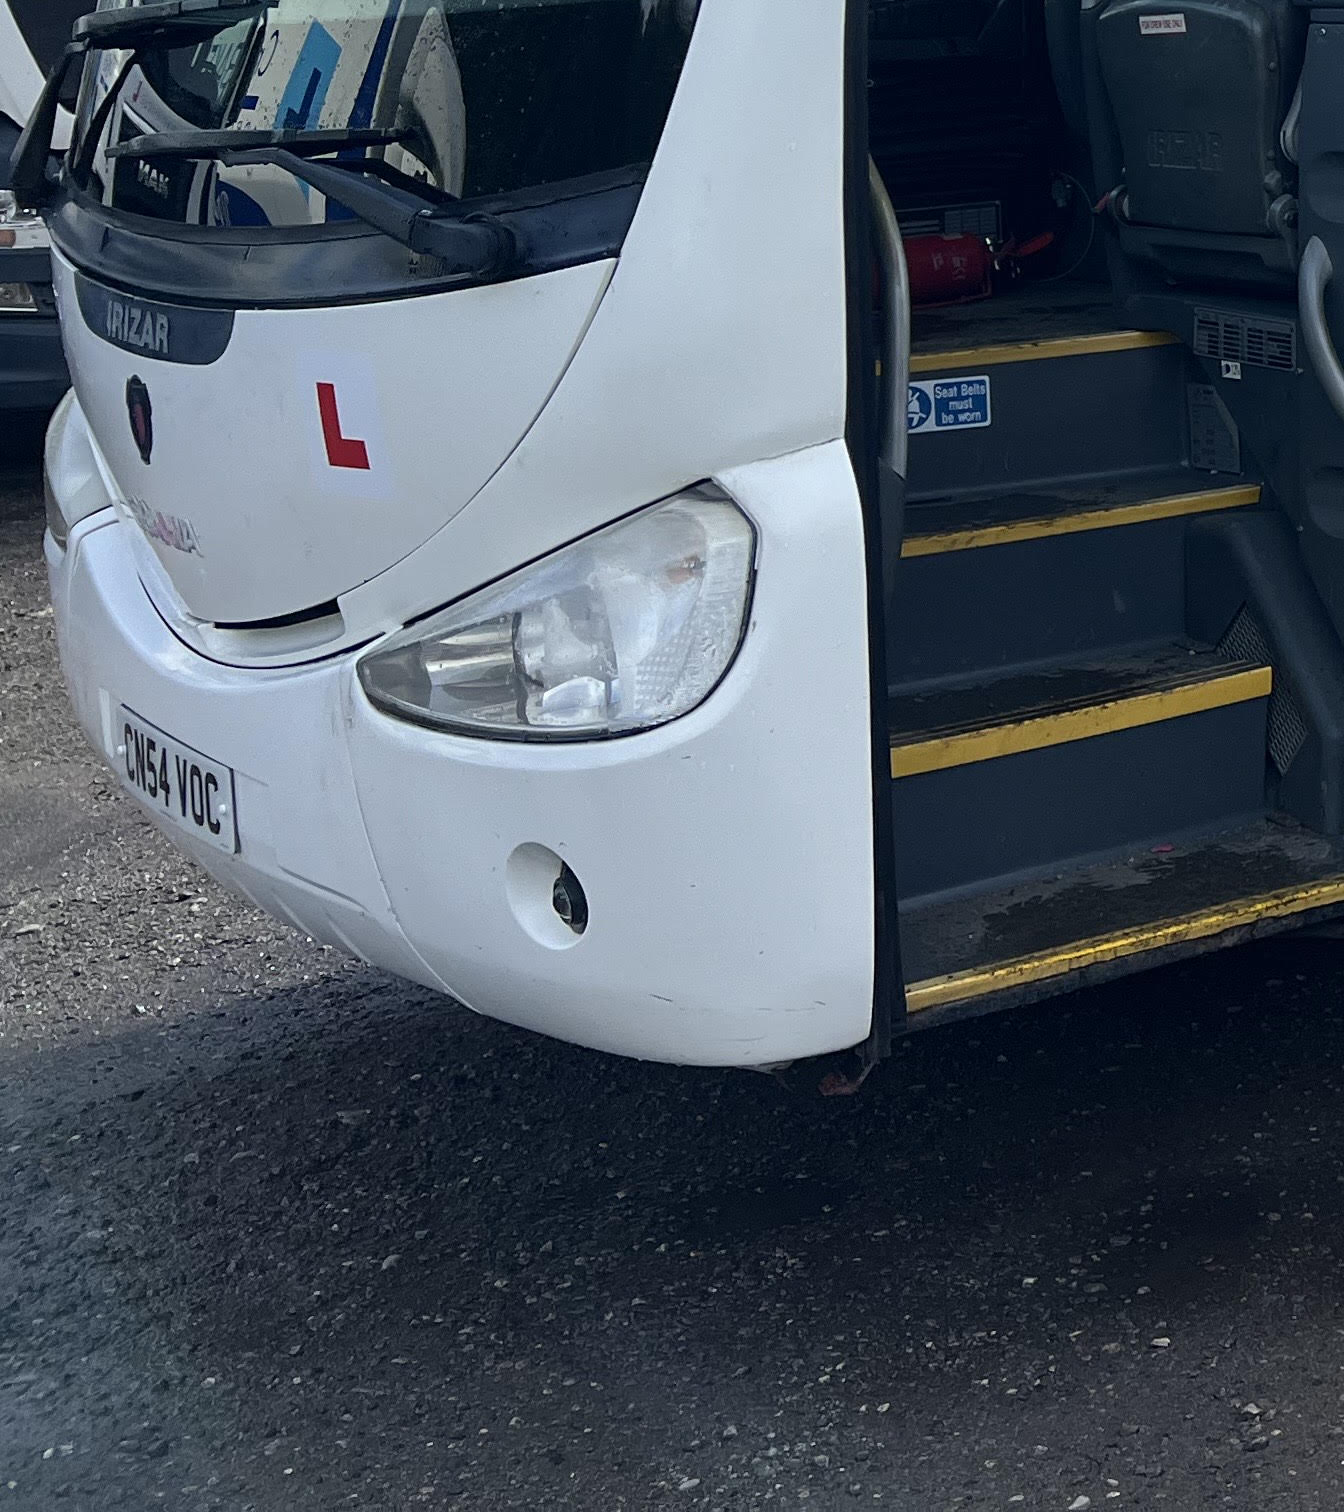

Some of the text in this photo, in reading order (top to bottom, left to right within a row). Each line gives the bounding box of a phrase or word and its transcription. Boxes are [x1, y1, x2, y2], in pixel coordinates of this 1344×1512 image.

[106, 300, 169, 354] IRIZAR
[935, 384, 986, 399] Seat Belts
[949, 397, 973, 410] must
[316, 382, 371, 470] L
[942, 411, 982, 424] be worn
[175, 754, 221, 835] VOC
